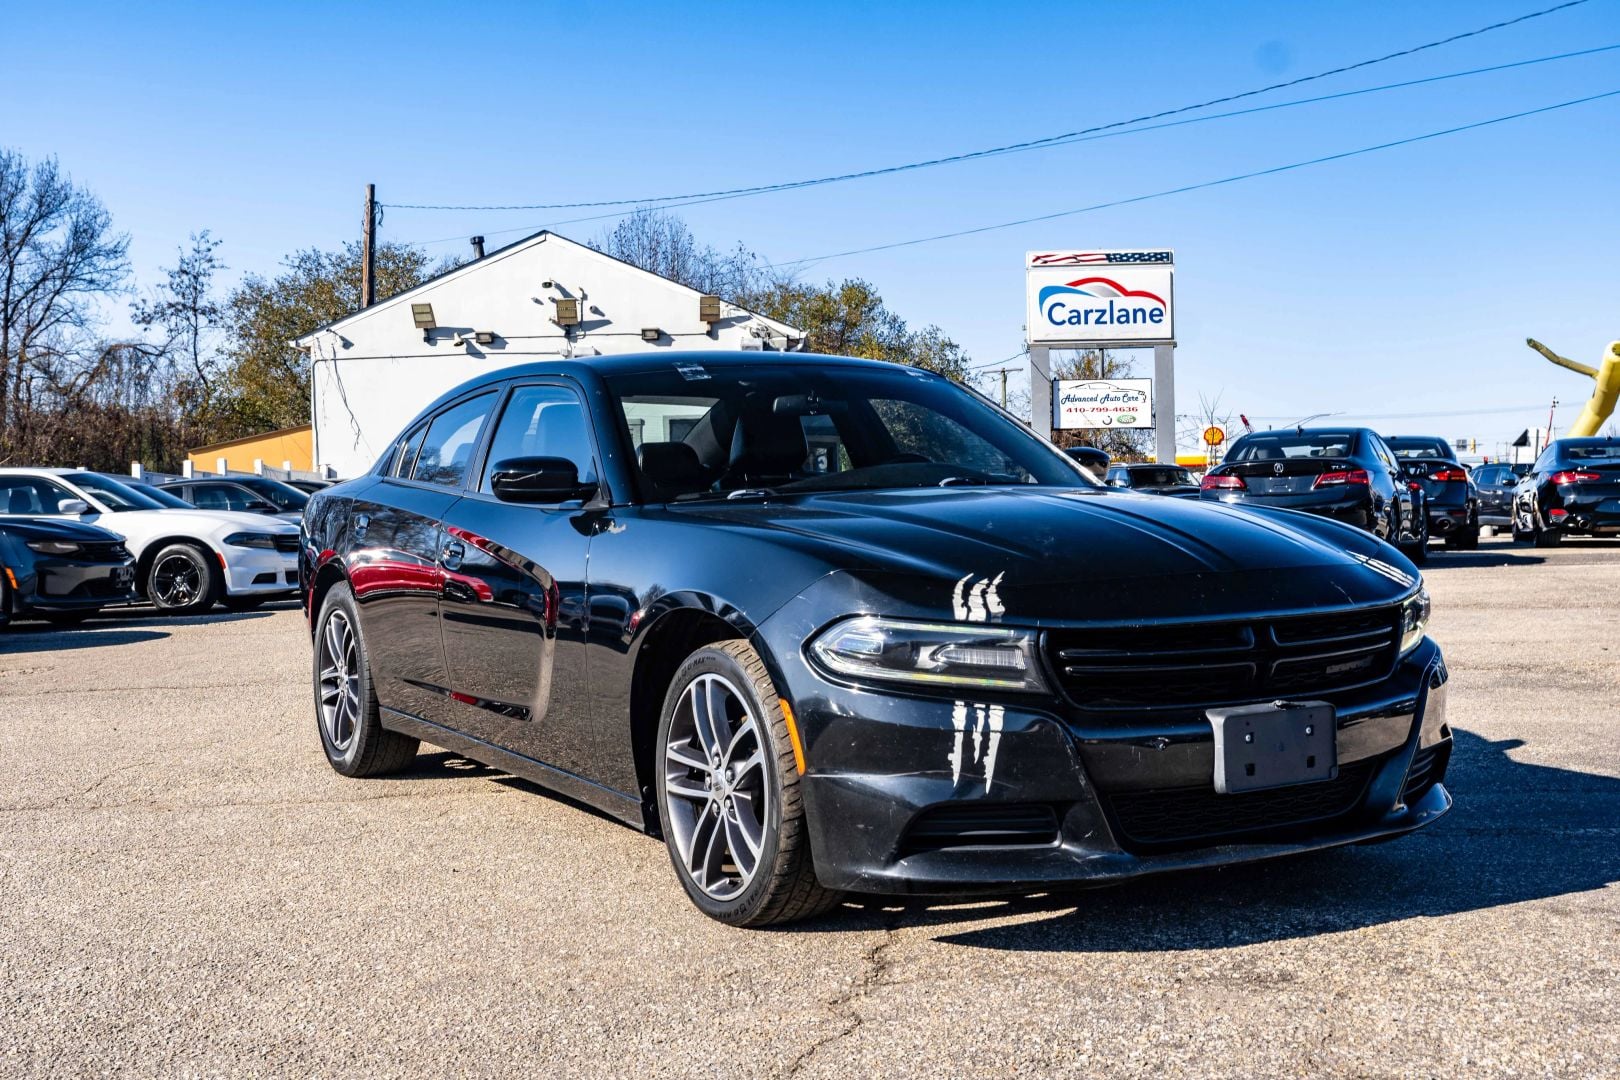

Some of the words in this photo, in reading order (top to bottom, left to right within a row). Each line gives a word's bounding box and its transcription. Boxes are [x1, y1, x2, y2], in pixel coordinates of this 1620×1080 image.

[1048, 300, 1164, 326] Carzlane
[1061, 394, 1098, 404] Advanced
[1100, 394, 1121, 404] Auto
[1122, 393, 1139, 403] Care
